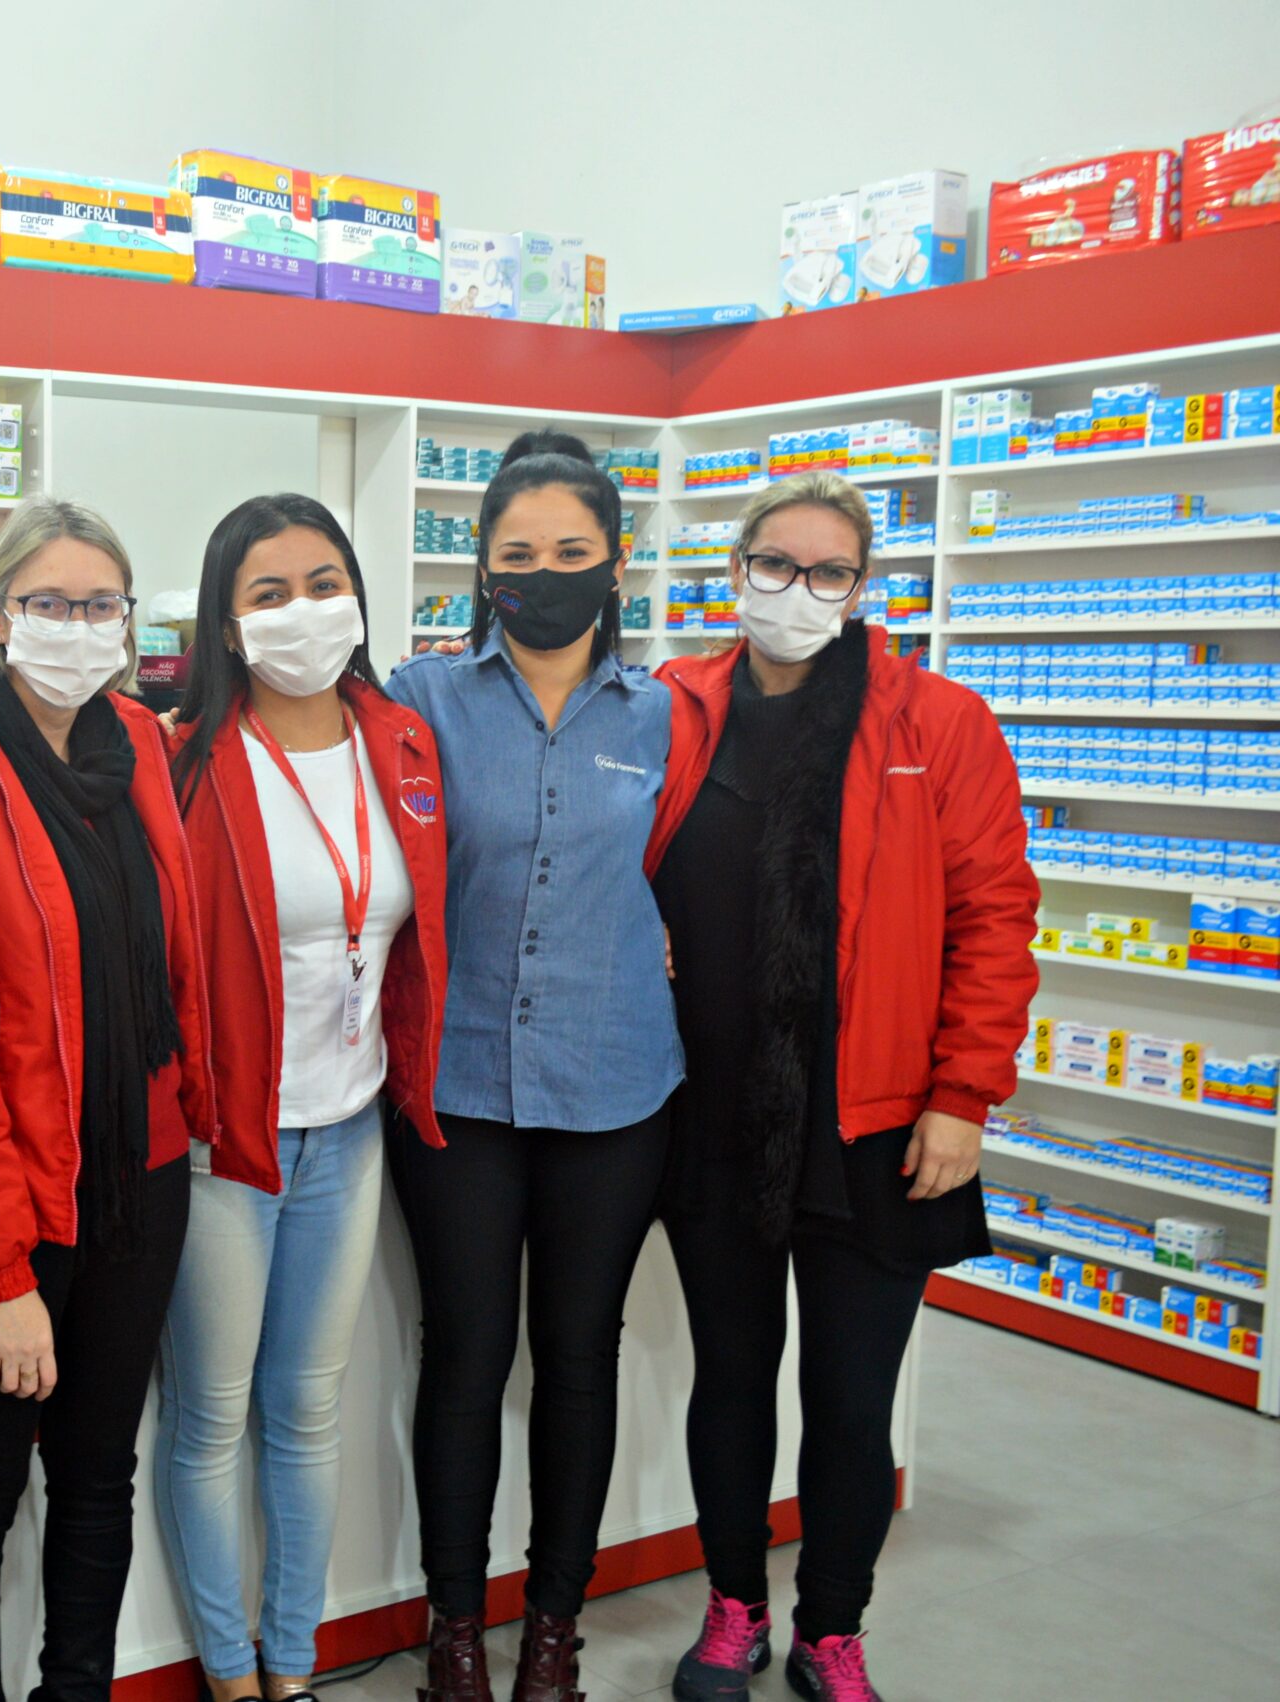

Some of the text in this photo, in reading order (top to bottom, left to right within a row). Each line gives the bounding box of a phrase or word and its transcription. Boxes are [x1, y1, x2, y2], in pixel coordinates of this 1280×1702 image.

[235, 185, 290, 211] BIGFRAL
[20, 214, 55, 226] Confort
[62, 201, 119, 223] BIGFRAL
[363, 208, 415, 232] BIGFRAL
[158, 661, 175, 670] NÃO
